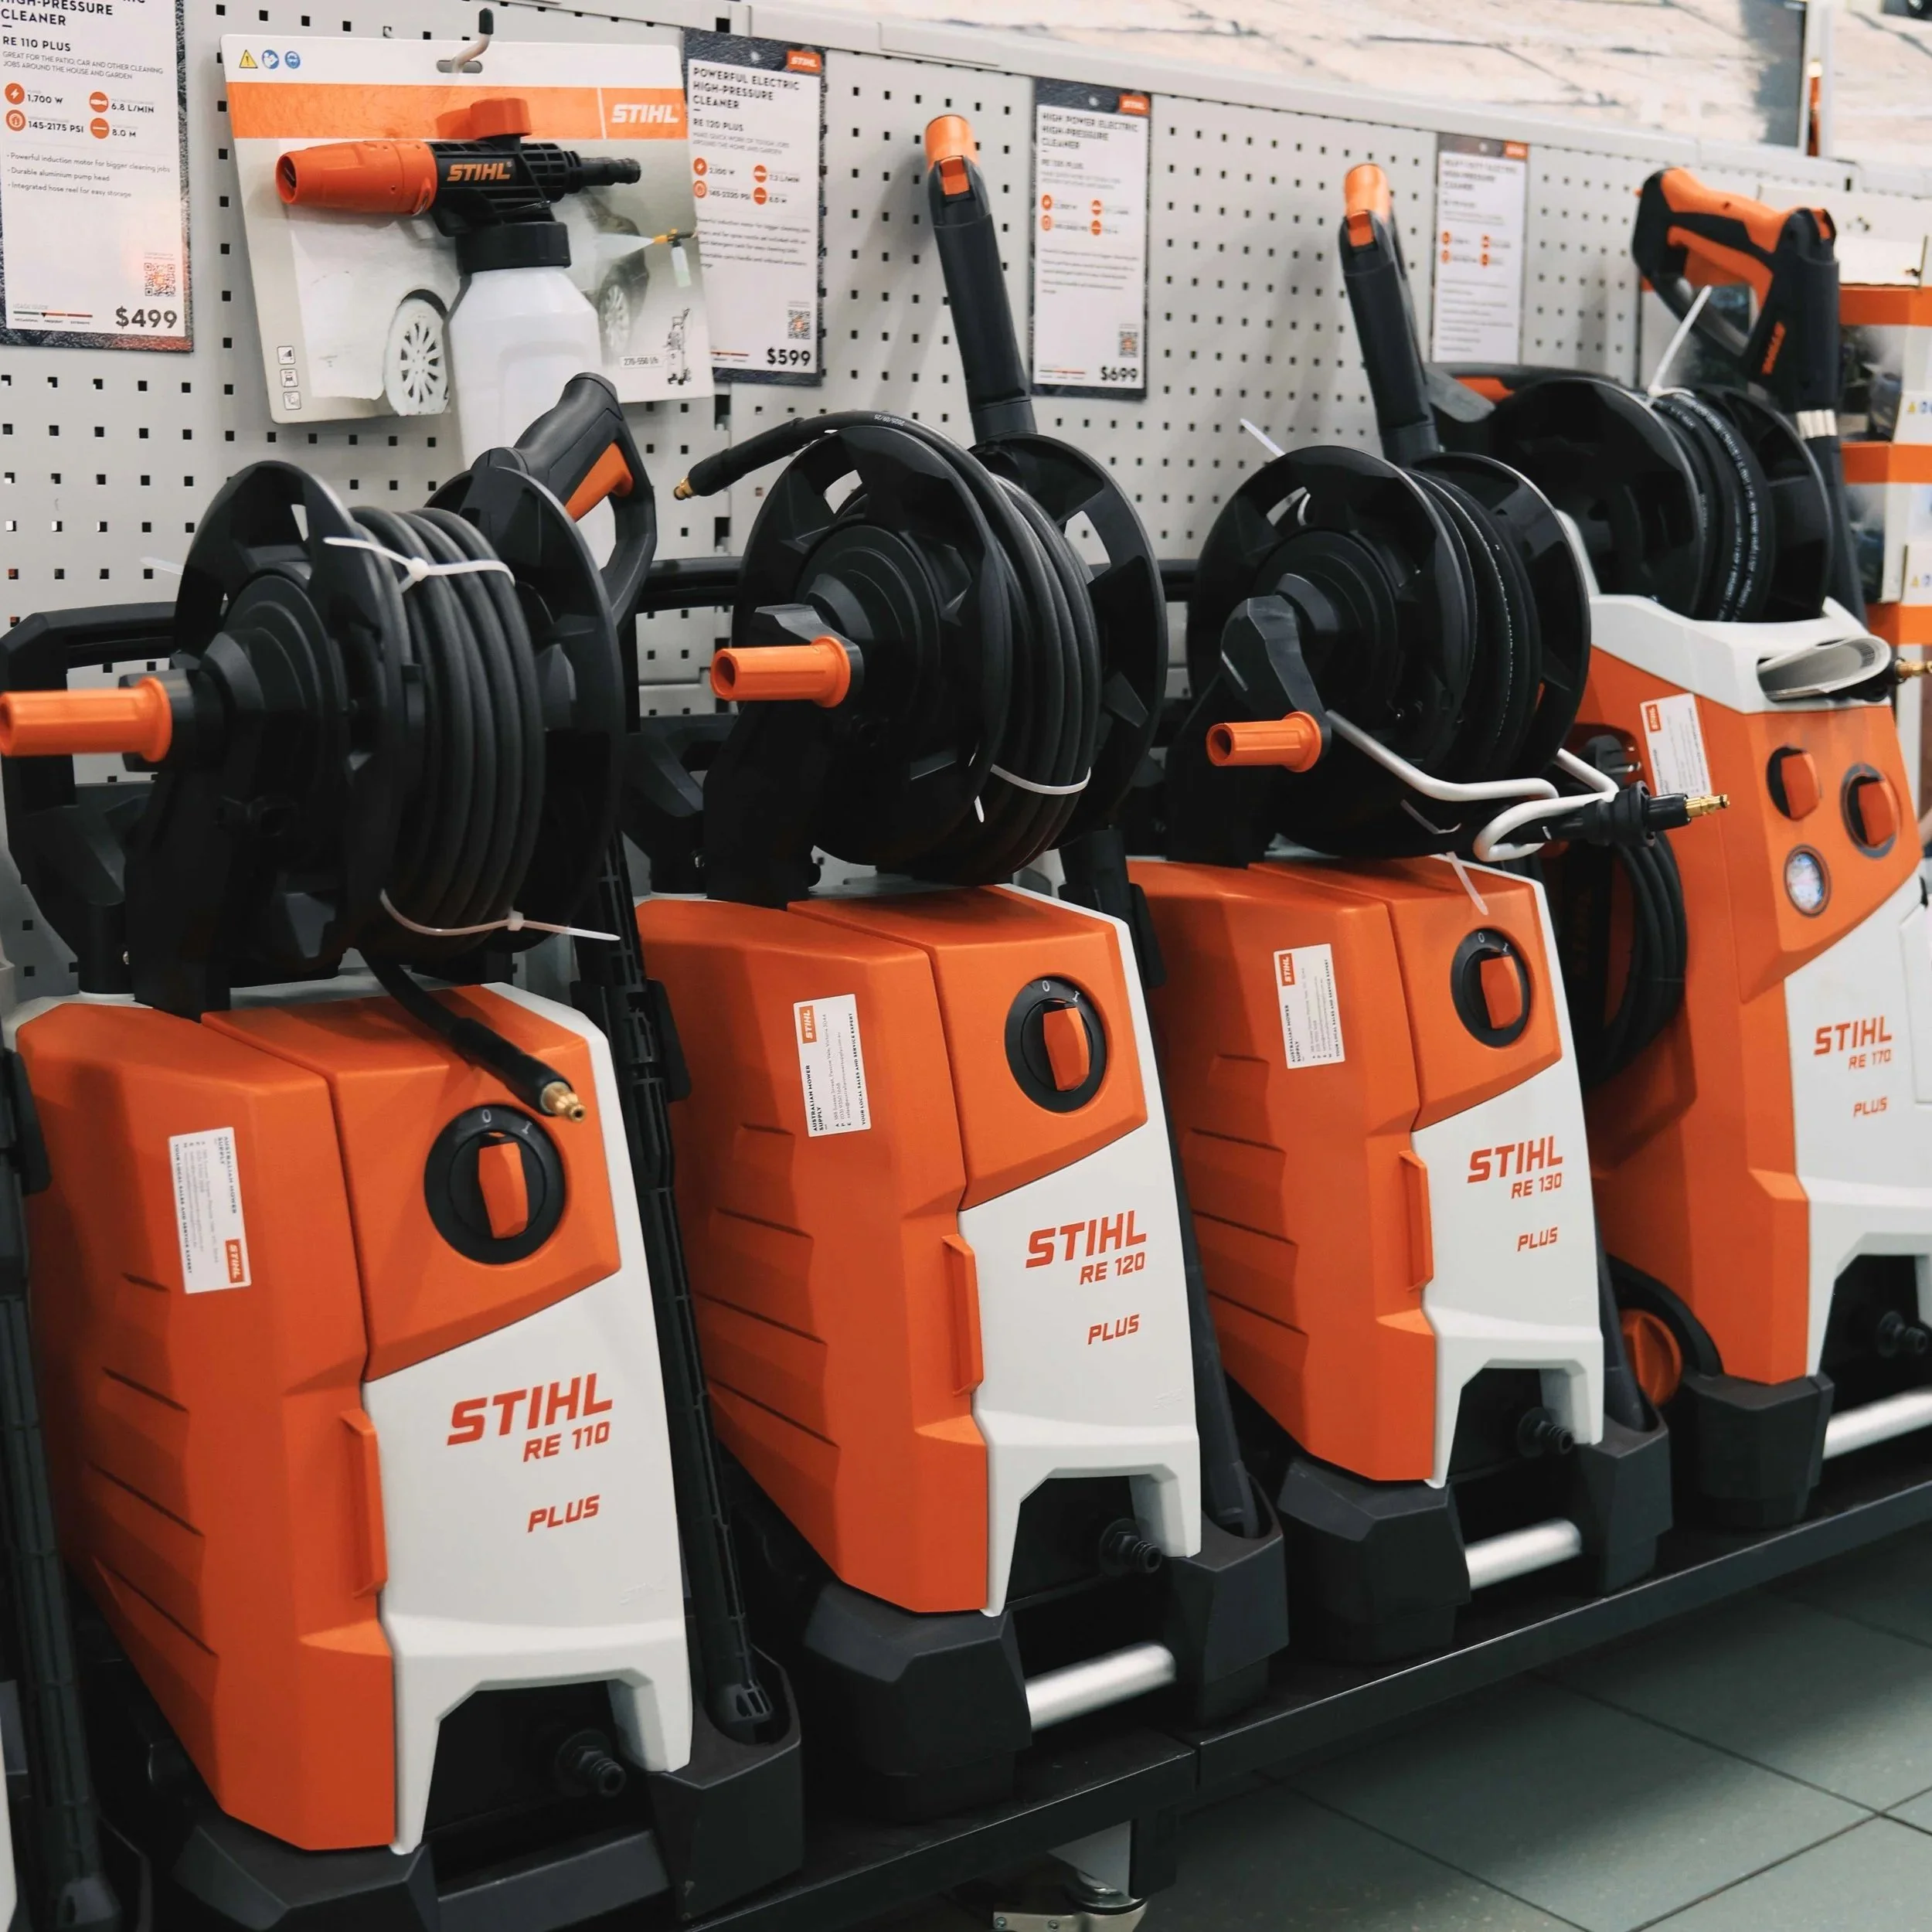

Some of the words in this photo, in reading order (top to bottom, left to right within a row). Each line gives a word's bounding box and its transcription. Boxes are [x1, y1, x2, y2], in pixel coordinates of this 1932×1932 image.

[0, 0, 113, 15] H-PRESSURE
[1, 9, 66, 26] CLEANER
[3, 36, 17, 46] RE
[21, 38, 38, 48] 110
[43, 40, 71, 52] PLUS
[22, 63, 50, 71] AROUND
[66, 66, 89, 75] HOUSE
[105, 71, 133, 80] GARDEN
[130, 64, 164, 74] CLEANING
[791, 56, 817, 68] STIHL
[693, 66, 749, 83] POWERFUL
[751, 76, 800, 91] ELECTRIC
[693, 81, 774, 100] HIGH-PRESSURE
[111, 103, 125, 111] 6.8
[128, 104, 155, 114] L/MIN
[611, 101, 679, 124] STIHL
[692, 95, 740, 109] CLEANER
[28, 121, 67, 131] 145-2175
[70, 124, 84, 133] PSI
[692, 117, 703, 128] RE
[723, 122, 744, 132] PLUS
[1042, 125, 1109, 141] HIGH-PRESSURE
[1043, 113, 1063, 122] HIGH
[1066, 115, 1095, 127] POWER
[1098, 120, 1139, 132] ELECTRIC
[10, 152, 40, 162] Powerful
[42, 155, 72, 164] induction
[106, 160, 128, 170] bigger
[129, 162, 155, 172] cleaning
[157, 165, 170, 173] jobs
[447, 161, 512, 183] STIHL
[11, 167, 37, 175] Durable
[39, 169, 72, 178] aluminium
[94, 173, 110, 182] head
[12, 182, 46, 192] Integrated
[48, 184, 63, 192] hose
[115, 305, 178, 329] $499
[767, 347, 811, 366] $599
[1100, 366, 1138, 382] $699
[1478, 932, 1485, 943] 0
[1283, 957, 1292, 982] STIHL
[1042, 980, 1050, 992] 0
[805, 1009, 814, 1039] STIHL
[1287, 1027, 1296, 1063] AUSTRALIAN
[1814, 1015, 1893, 1056] STIHL
[1848, 1053, 1866, 1071] RE
[1871, 1049, 1892, 1065] 170
[481, 1109, 492, 1123] 0
[809, 1090, 818, 1131] AUSTRALIAN
[1852, 1096, 1888, 1117] PLUS
[224, 1136, 233, 1183] AUSTRALIAN
[1467, 1135, 1563, 1183] STIHL
[1511, 1179, 1533, 1199] RE
[1539, 1172, 1562, 1192] 130
[1026, 1210, 1147, 1268] STIHL
[1517, 1226, 1558, 1252] PLUS
[229, 1243, 241, 1279] STIHL
[1080, 1261, 1107, 1285] RE
[1115, 1252, 1145, 1276] 120
[1088, 1314, 1140, 1345] PLUS
[447, 1372, 613, 1446] STIHL
[523, 1433, 562, 1463] RE
[572, 1421, 611, 1450] 110
[527, 1495, 600, 1533] PLUS
